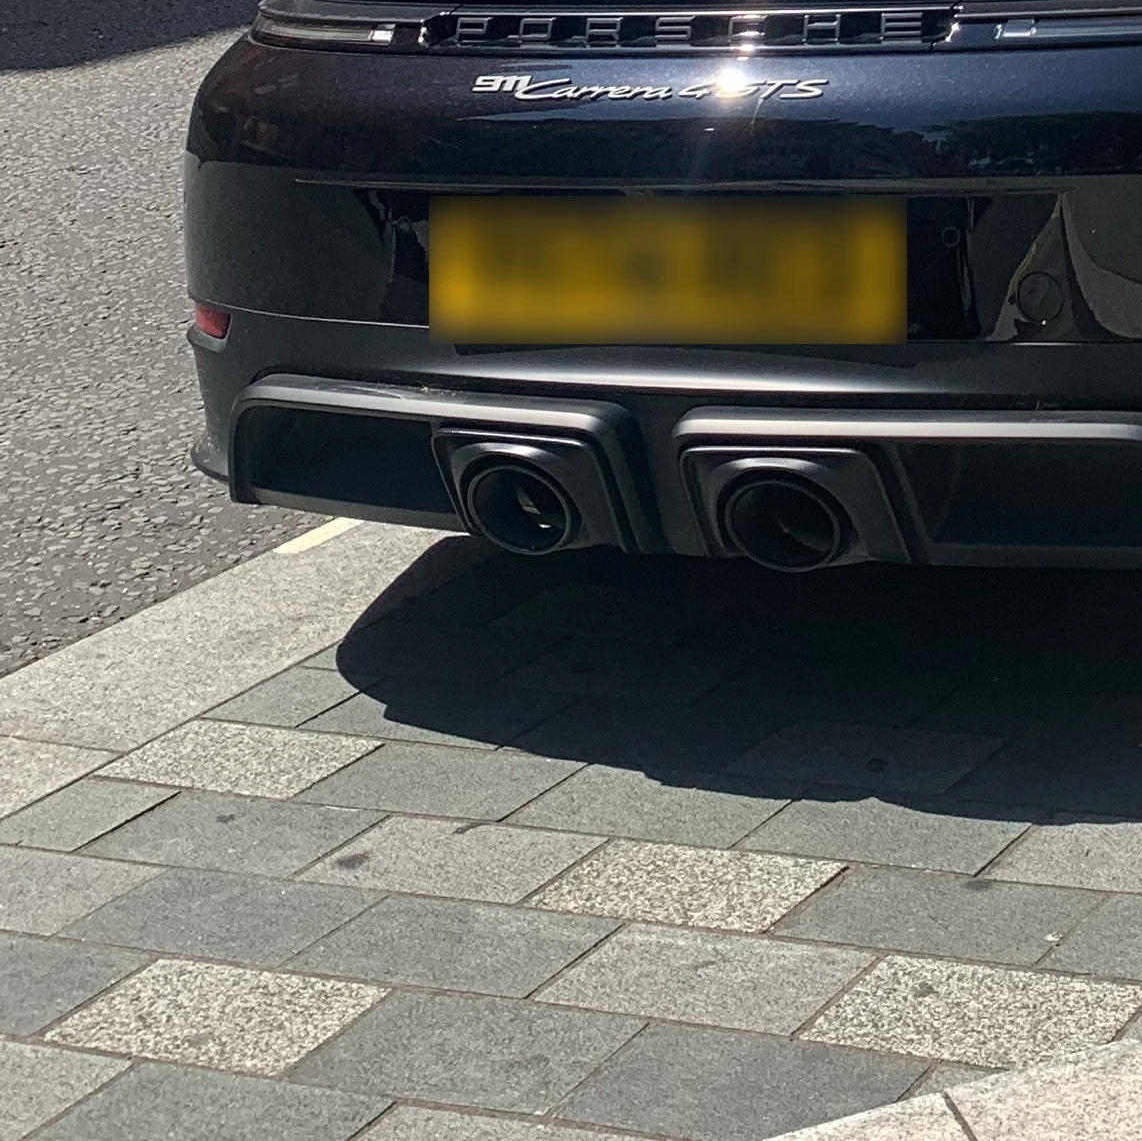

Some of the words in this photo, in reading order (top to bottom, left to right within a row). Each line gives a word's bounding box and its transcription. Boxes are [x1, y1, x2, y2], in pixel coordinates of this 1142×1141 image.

[454, 12, 925, 48] PORSCHE
[472, 75, 531, 93] 911
[515, 77, 672, 101] Carrera
[714, 77, 829, 100] GTS
